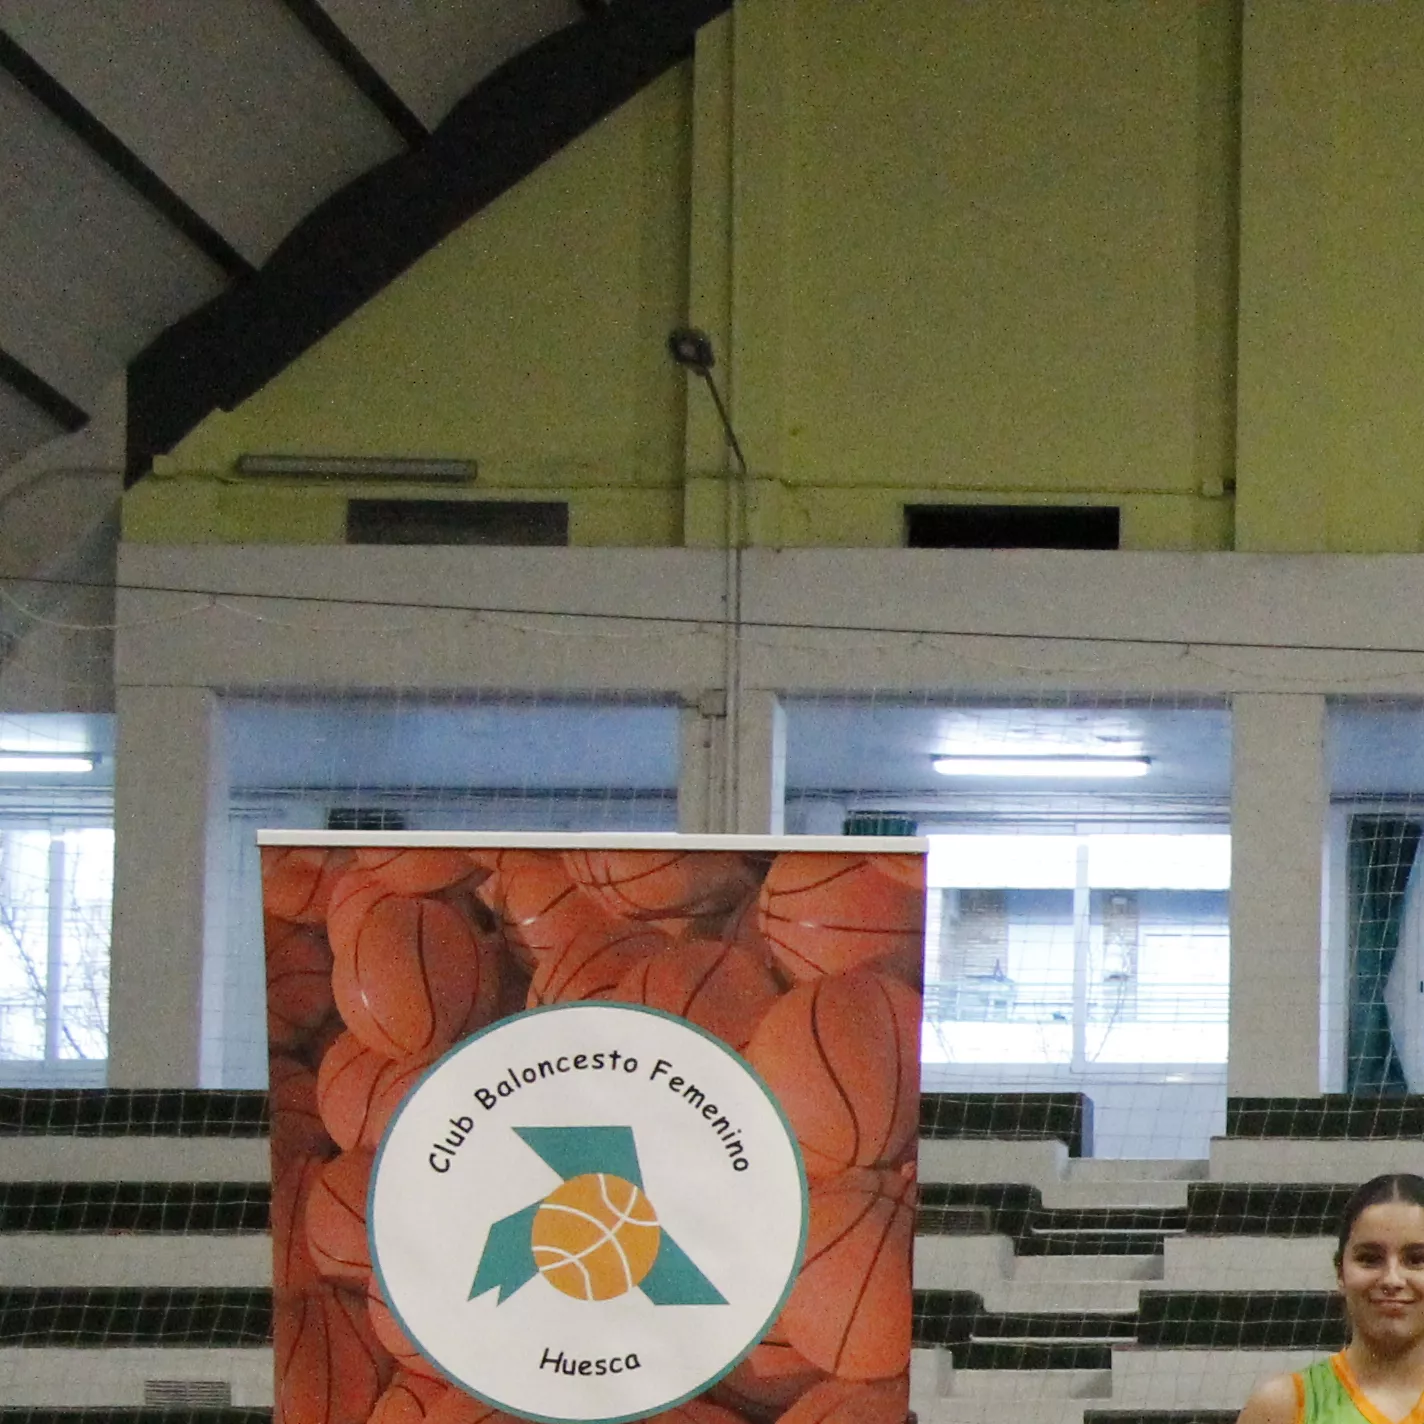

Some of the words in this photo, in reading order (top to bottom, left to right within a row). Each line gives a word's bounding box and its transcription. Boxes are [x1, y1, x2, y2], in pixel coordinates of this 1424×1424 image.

[429, 1115, 474, 1174] Club
[474, 1050, 638, 1110] Baloncesto
[649, 1059, 749, 1172] Femenino
[539, 1347, 642, 1376] Huesca
